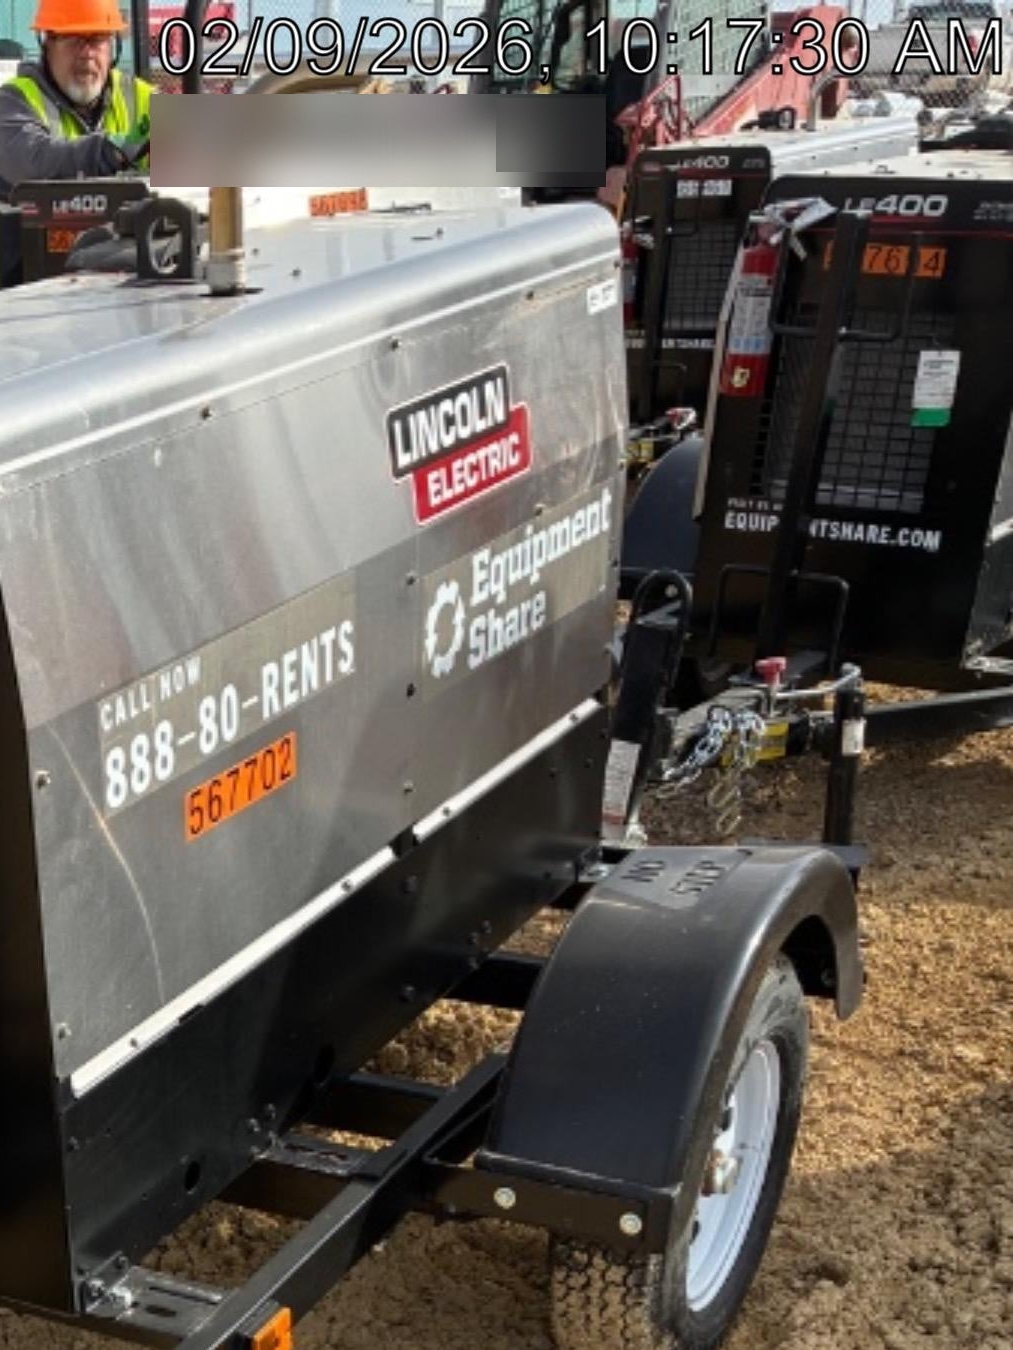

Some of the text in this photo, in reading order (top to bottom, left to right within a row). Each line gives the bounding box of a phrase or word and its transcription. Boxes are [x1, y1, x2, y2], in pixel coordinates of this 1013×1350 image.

[844, 194, 949, 216] LE400
[393, 378, 505, 467] LINCOLN
[426, 434, 521, 507] ELECTRIC
[470, 487, 612, 607] Equipment
[724, 511, 942, 550] EQUIPNTSHARE.COM
[467, 590, 547, 670] Share
[100, 655, 202, 732] CALL NOW
[105, 620, 355, 808] 888-80-RENTS
[189, 737, 293, 836] 567702
